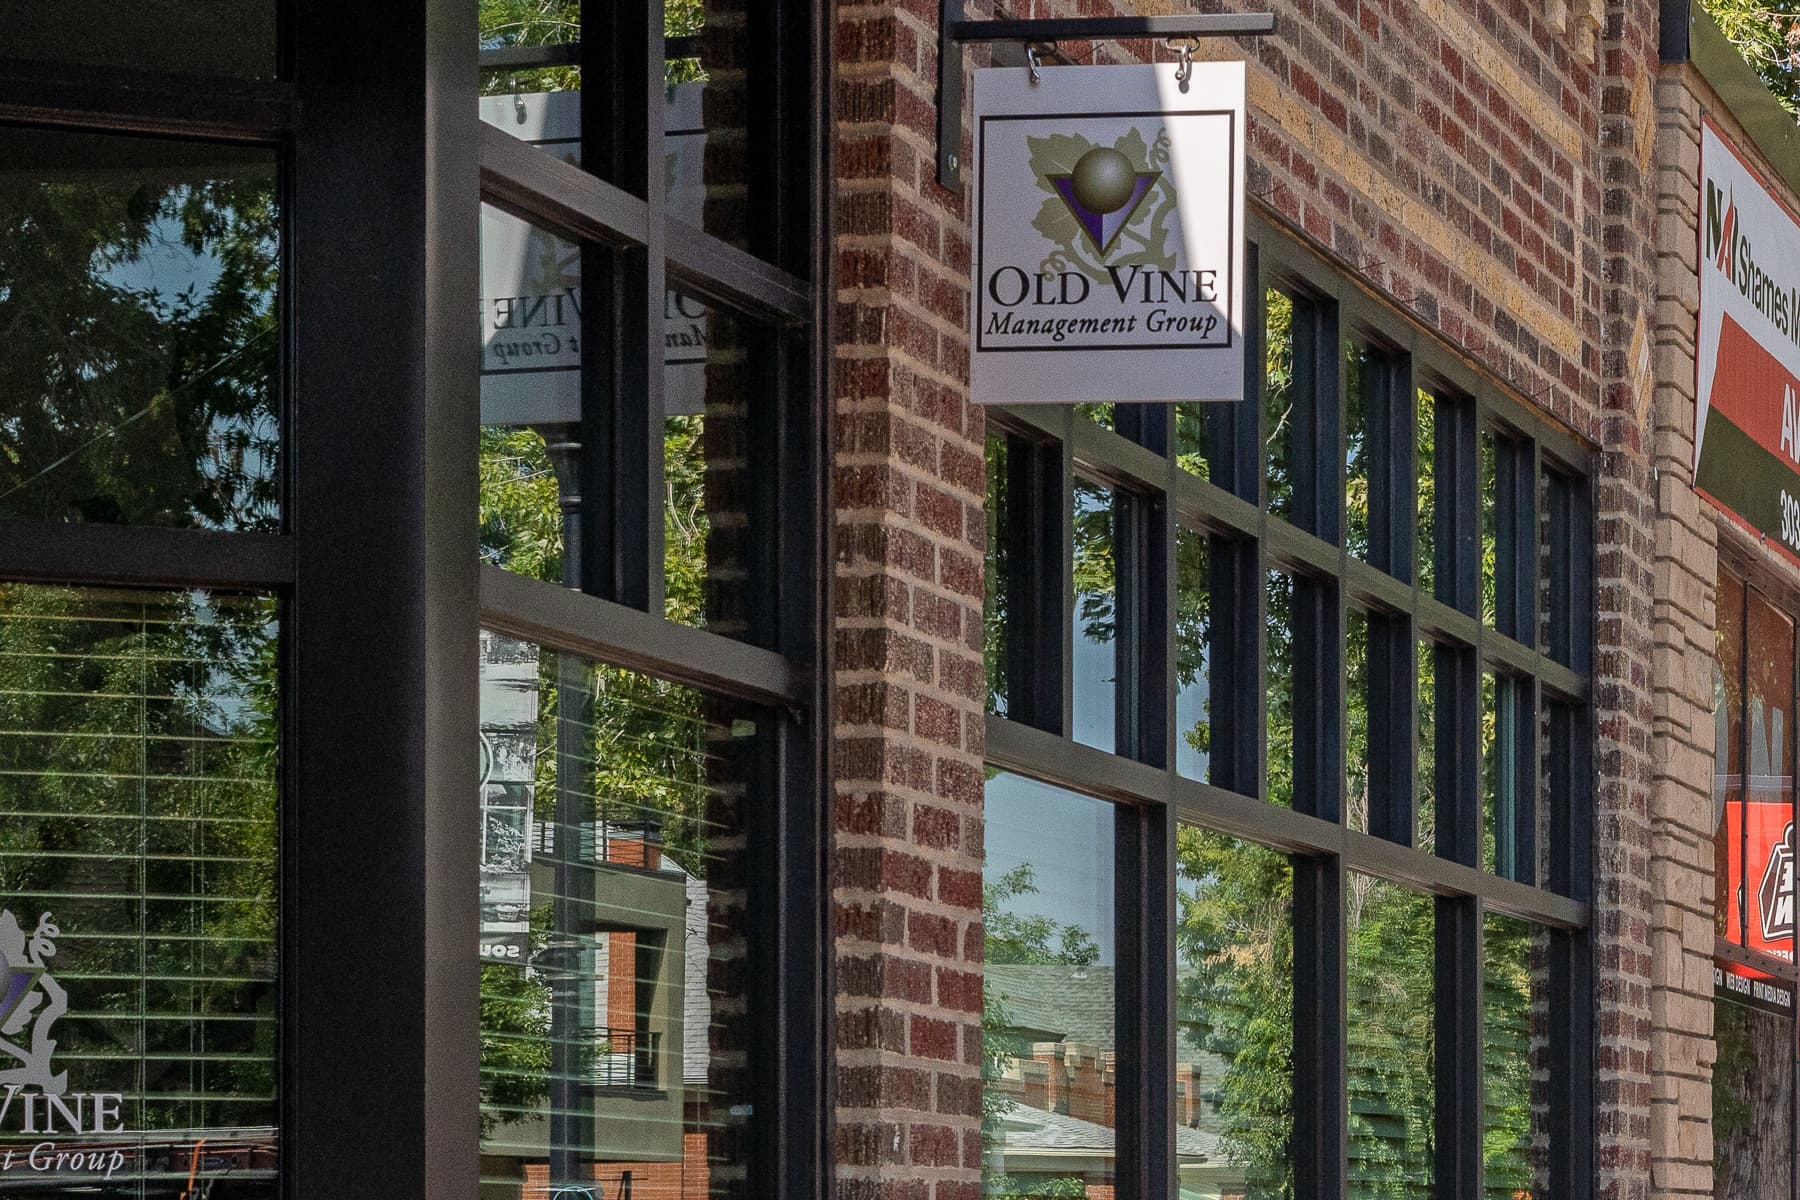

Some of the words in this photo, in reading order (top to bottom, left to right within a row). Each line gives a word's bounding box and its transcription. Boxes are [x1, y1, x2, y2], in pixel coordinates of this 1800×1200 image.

[1706, 177, 1738, 286] NAI
[1739, 235, 1788, 337] Shames
[988, 266, 1090, 307] OLD
[1105, 264, 1218, 304] VINE
[985, 312, 1137, 342] Management
[1146, 309, 1217, 340] Group
[29, 1142, 124, 1180] Group
